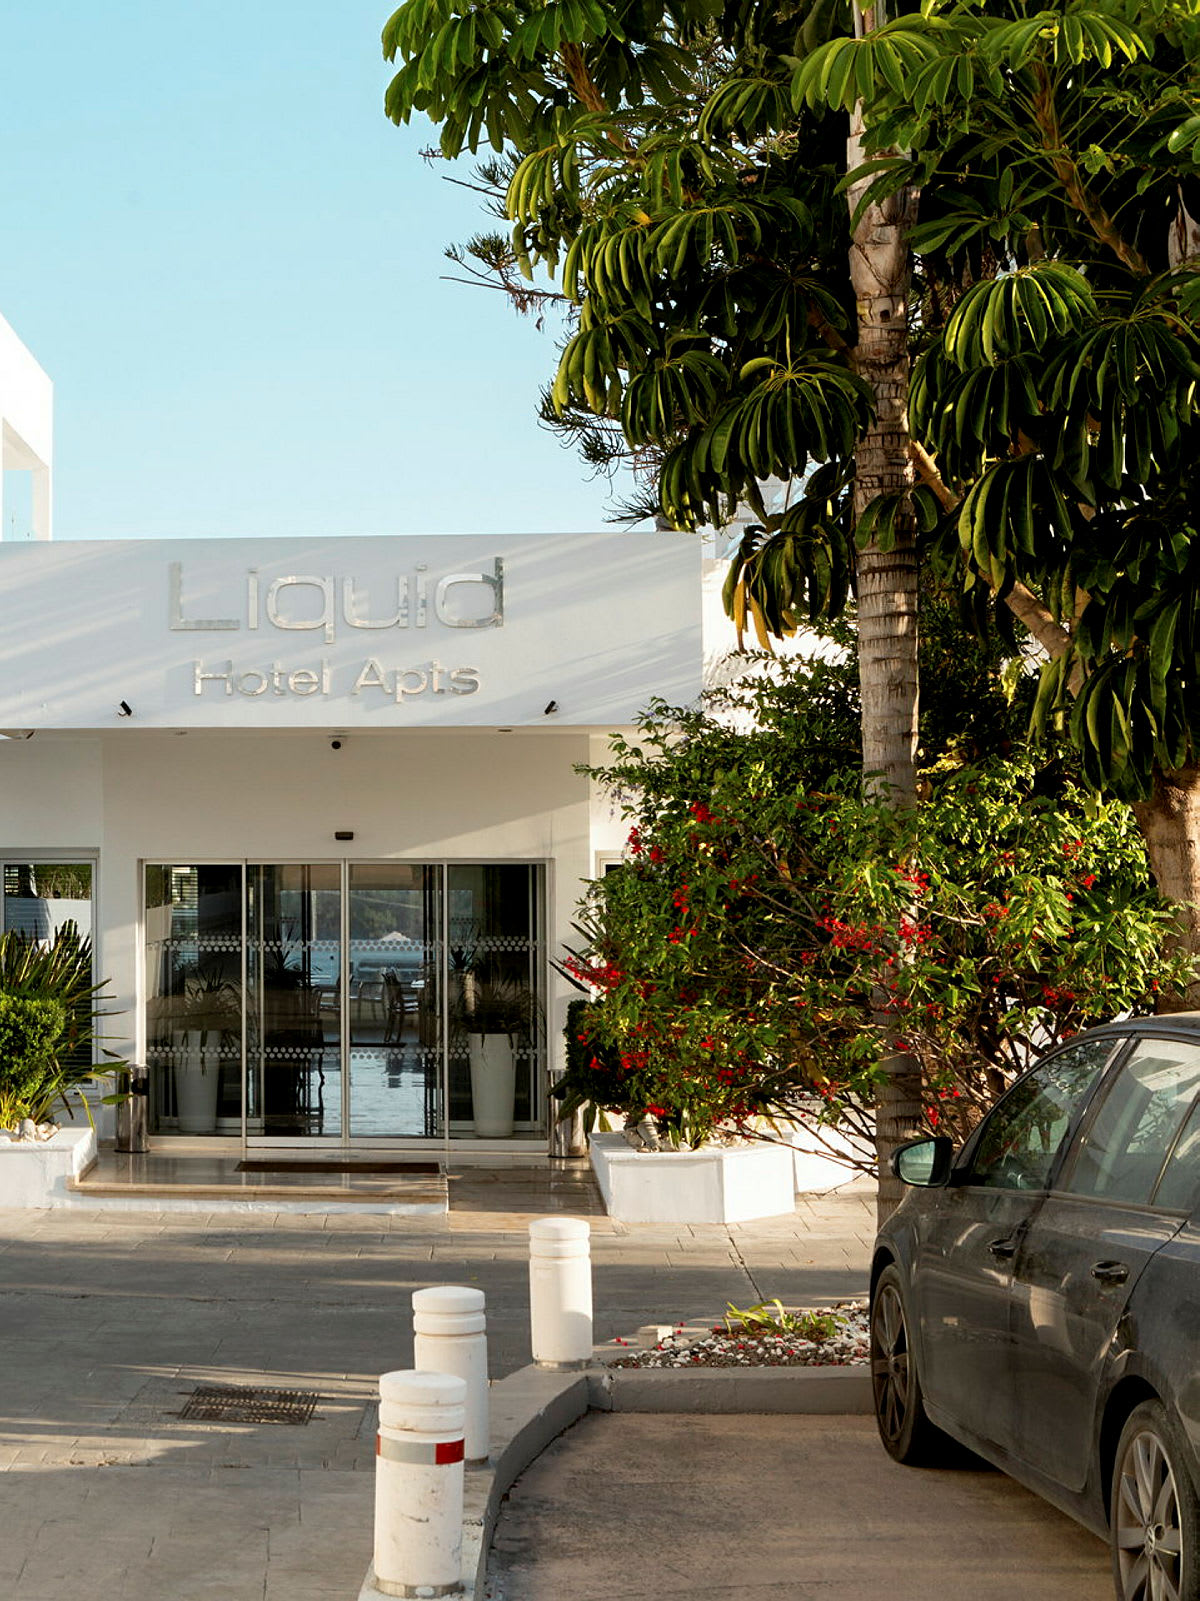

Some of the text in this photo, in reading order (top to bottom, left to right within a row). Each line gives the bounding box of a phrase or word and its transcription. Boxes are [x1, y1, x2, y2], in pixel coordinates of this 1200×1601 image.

[168, 556, 504, 644] Liquid
[193, 657, 481, 702] Hotel Apts
